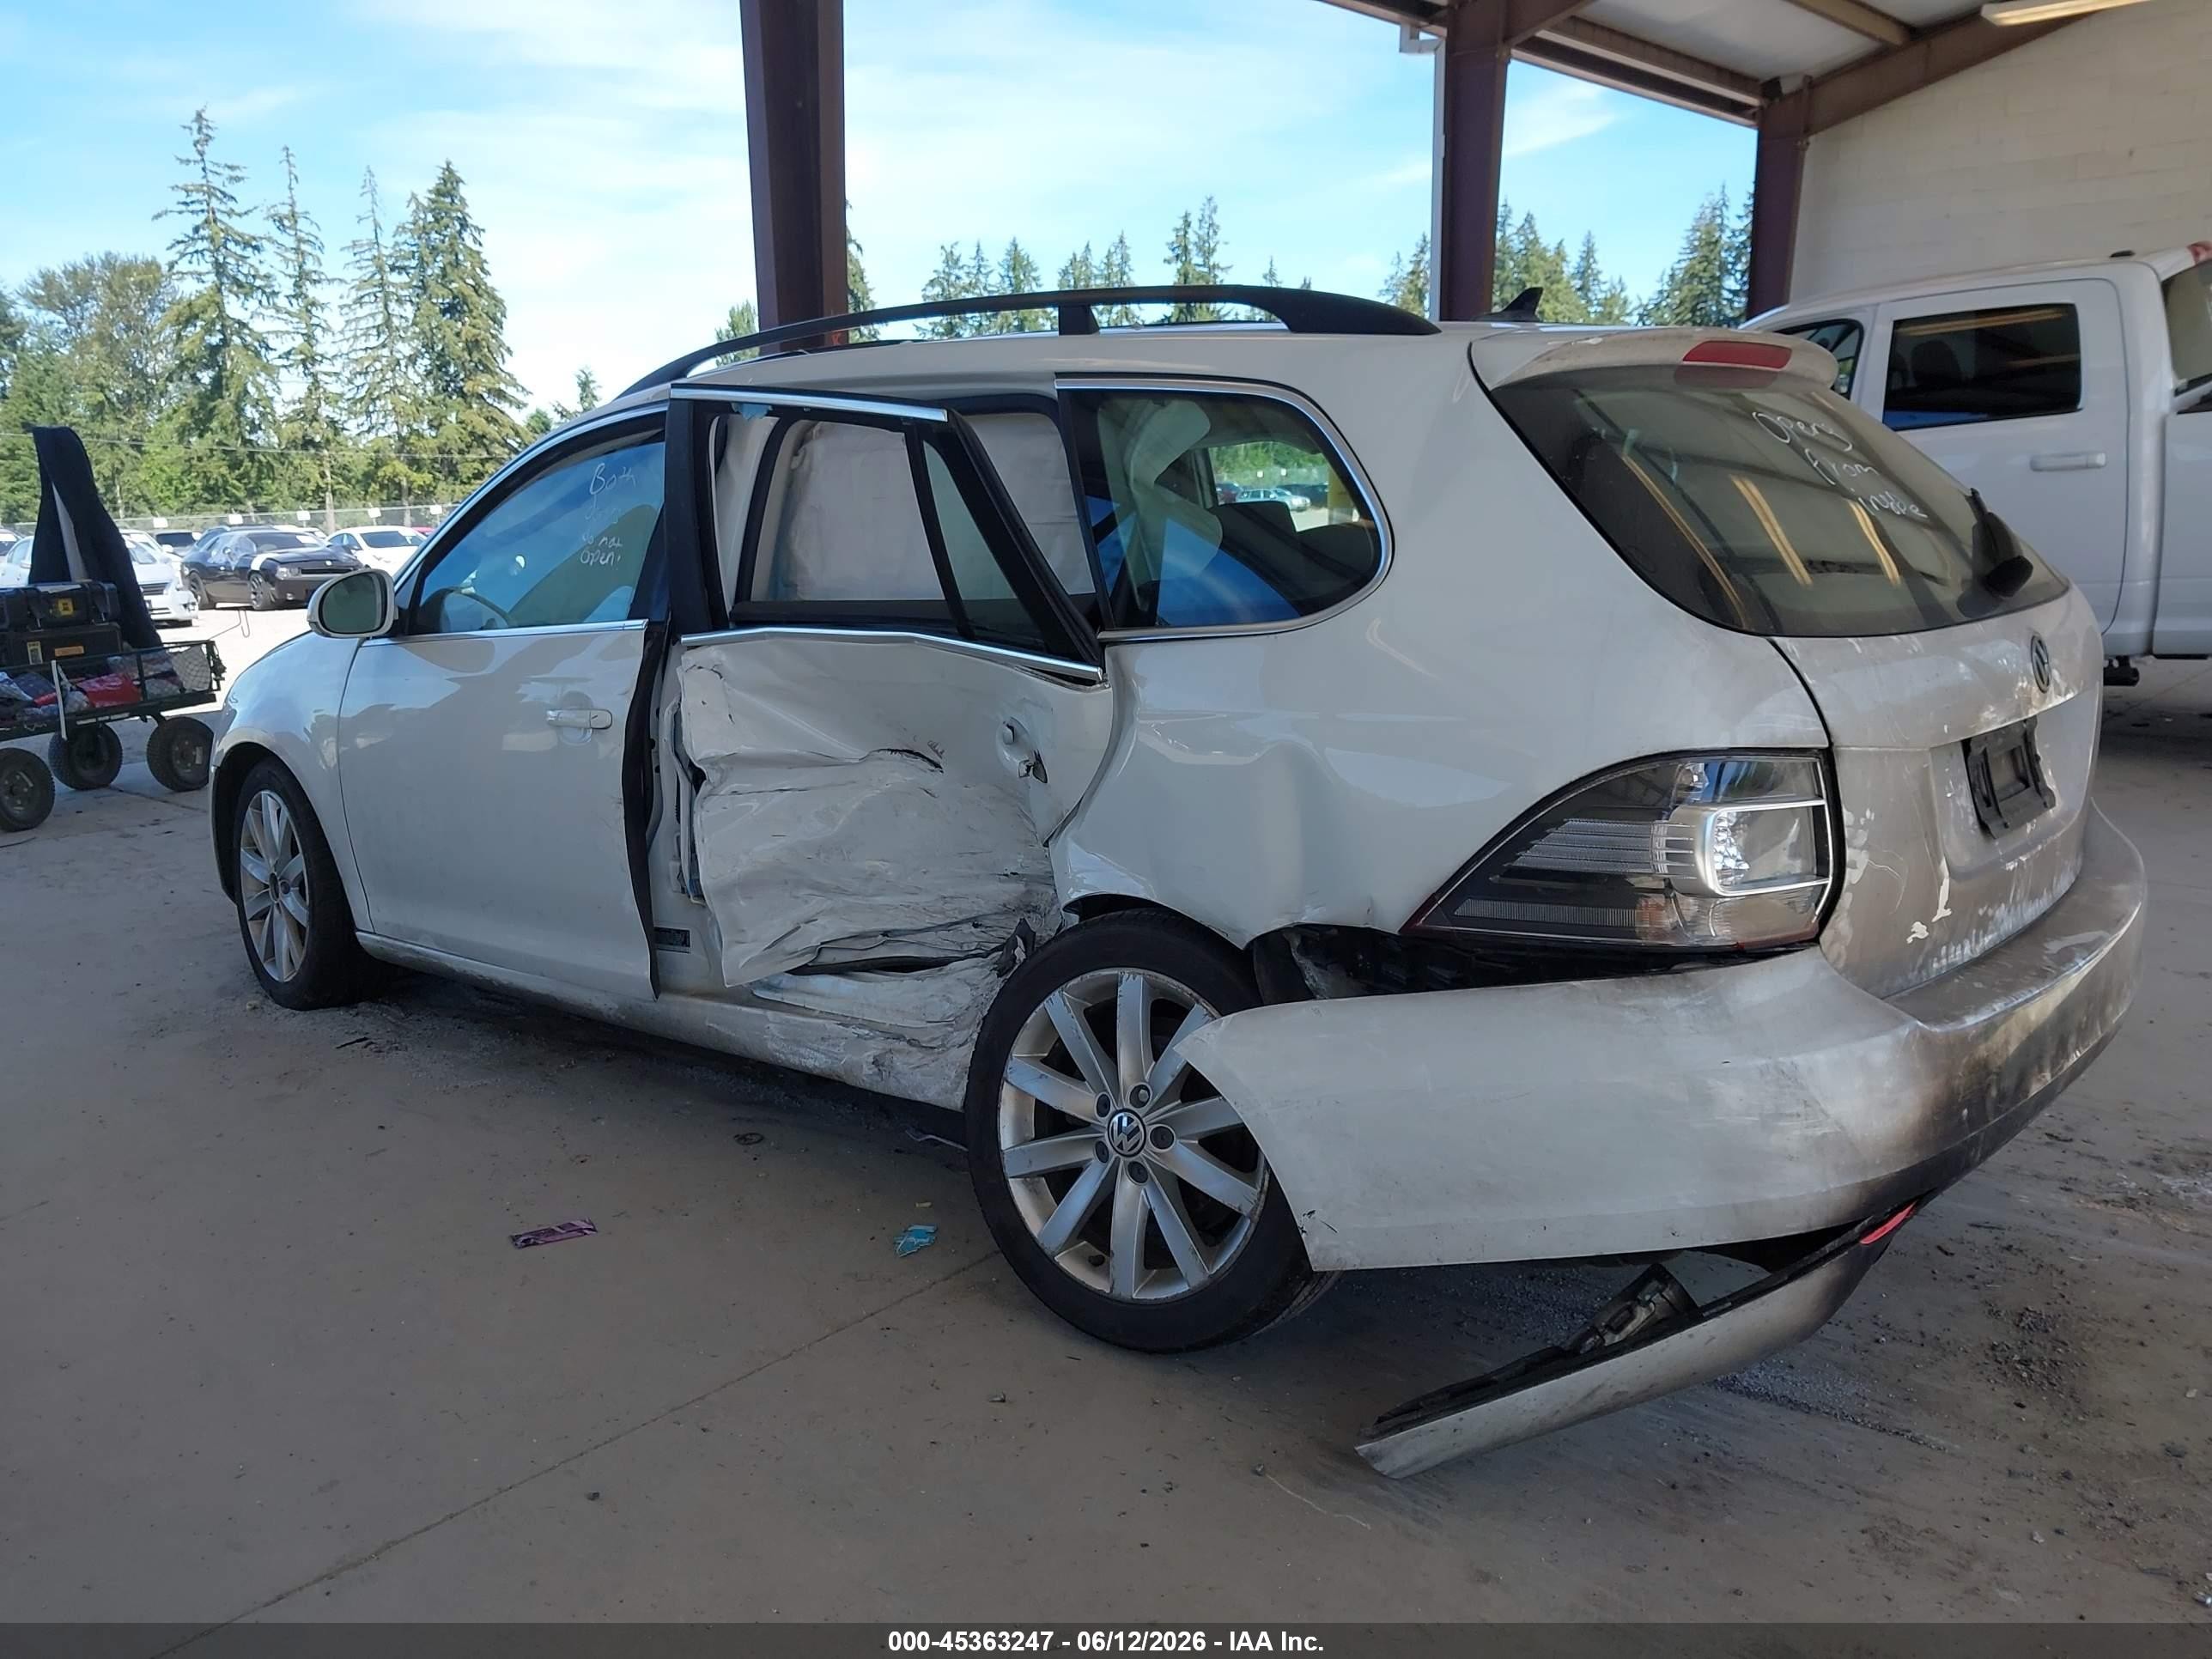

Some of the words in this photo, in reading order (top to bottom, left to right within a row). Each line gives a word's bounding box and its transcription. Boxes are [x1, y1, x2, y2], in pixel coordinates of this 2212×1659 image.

[588, 462, 637, 495] Both
[1805, 448, 1879, 486] from
[598, 536, 623, 549] not
